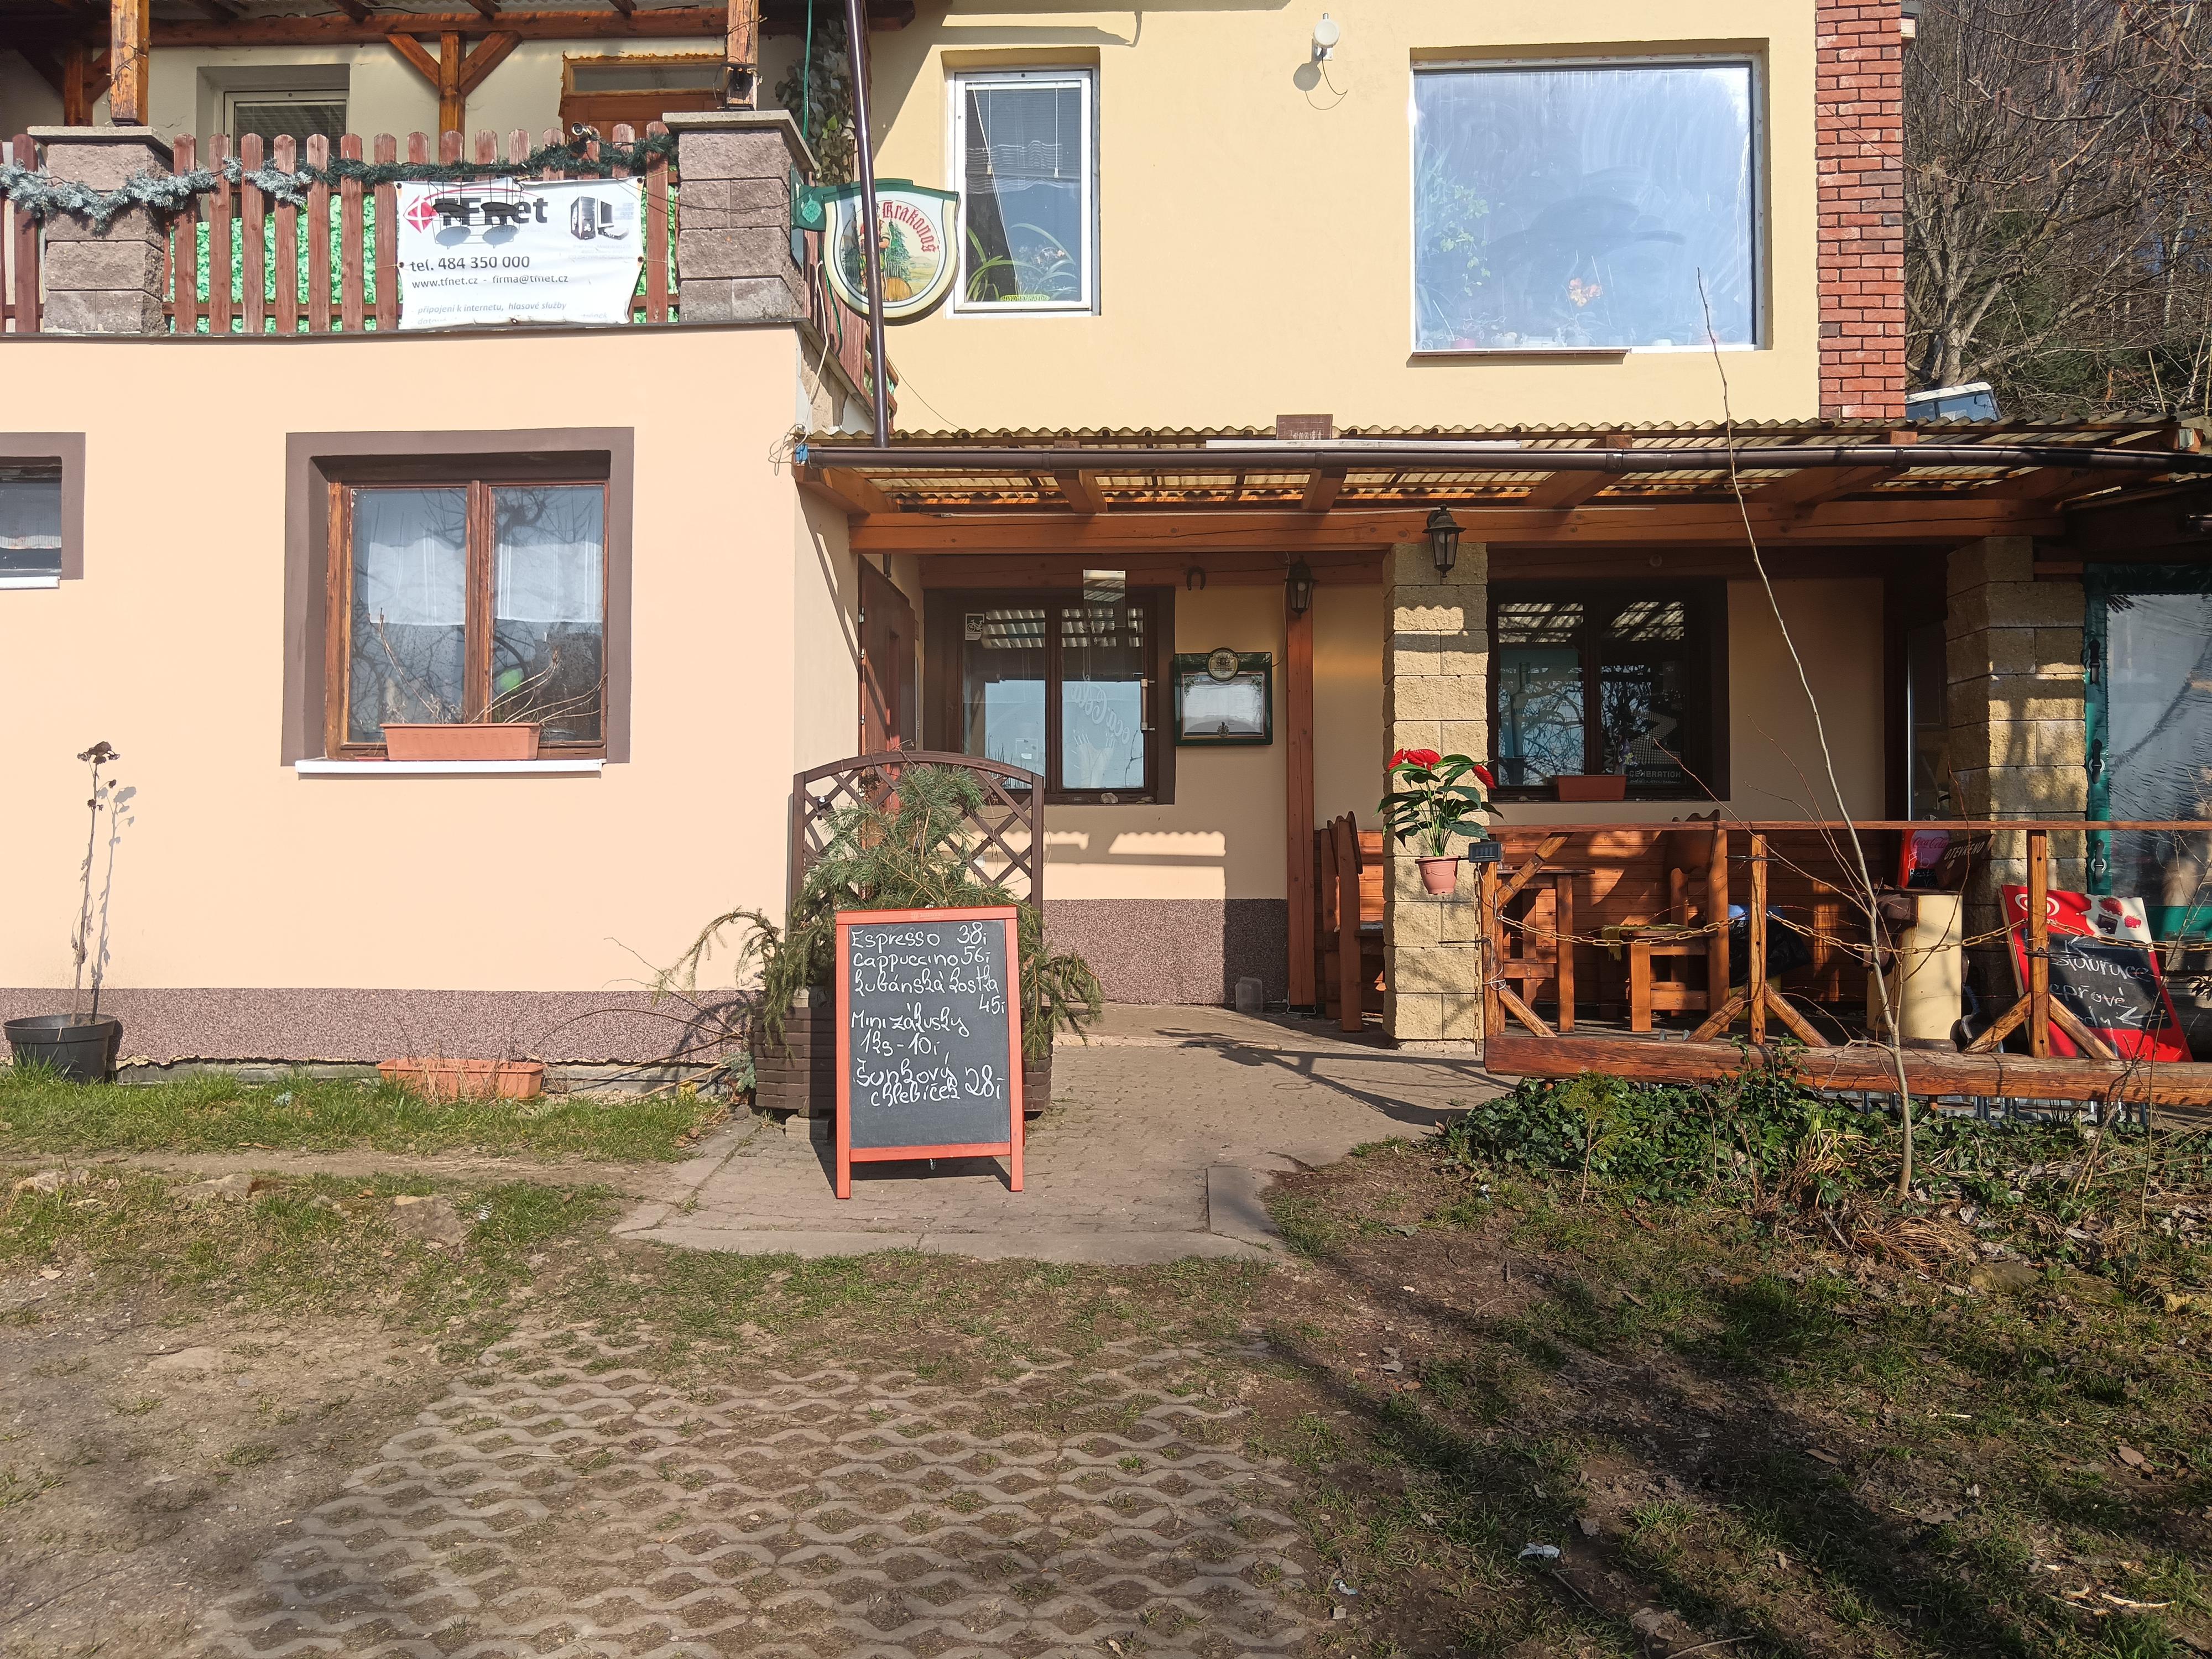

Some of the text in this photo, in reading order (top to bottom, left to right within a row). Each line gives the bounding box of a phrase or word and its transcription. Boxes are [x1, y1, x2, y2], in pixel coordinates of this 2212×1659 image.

[882, 201, 939, 253] Krakonoš
[410, 256, 530, 272] tel. 484 350 000
[412, 277, 478, 289] www.tfnet.cz
[493, 275, 568, 284] firma@tfnet.cz
[418, 305, 455, 315] připojení
[463, 304, 504, 312] internetu,
[508, 302, 540, 310] hlasové
[541, 301, 567, 311] služby
[851, 929, 940, 953] Espresso
[851, 1009, 886, 1029] Mini
